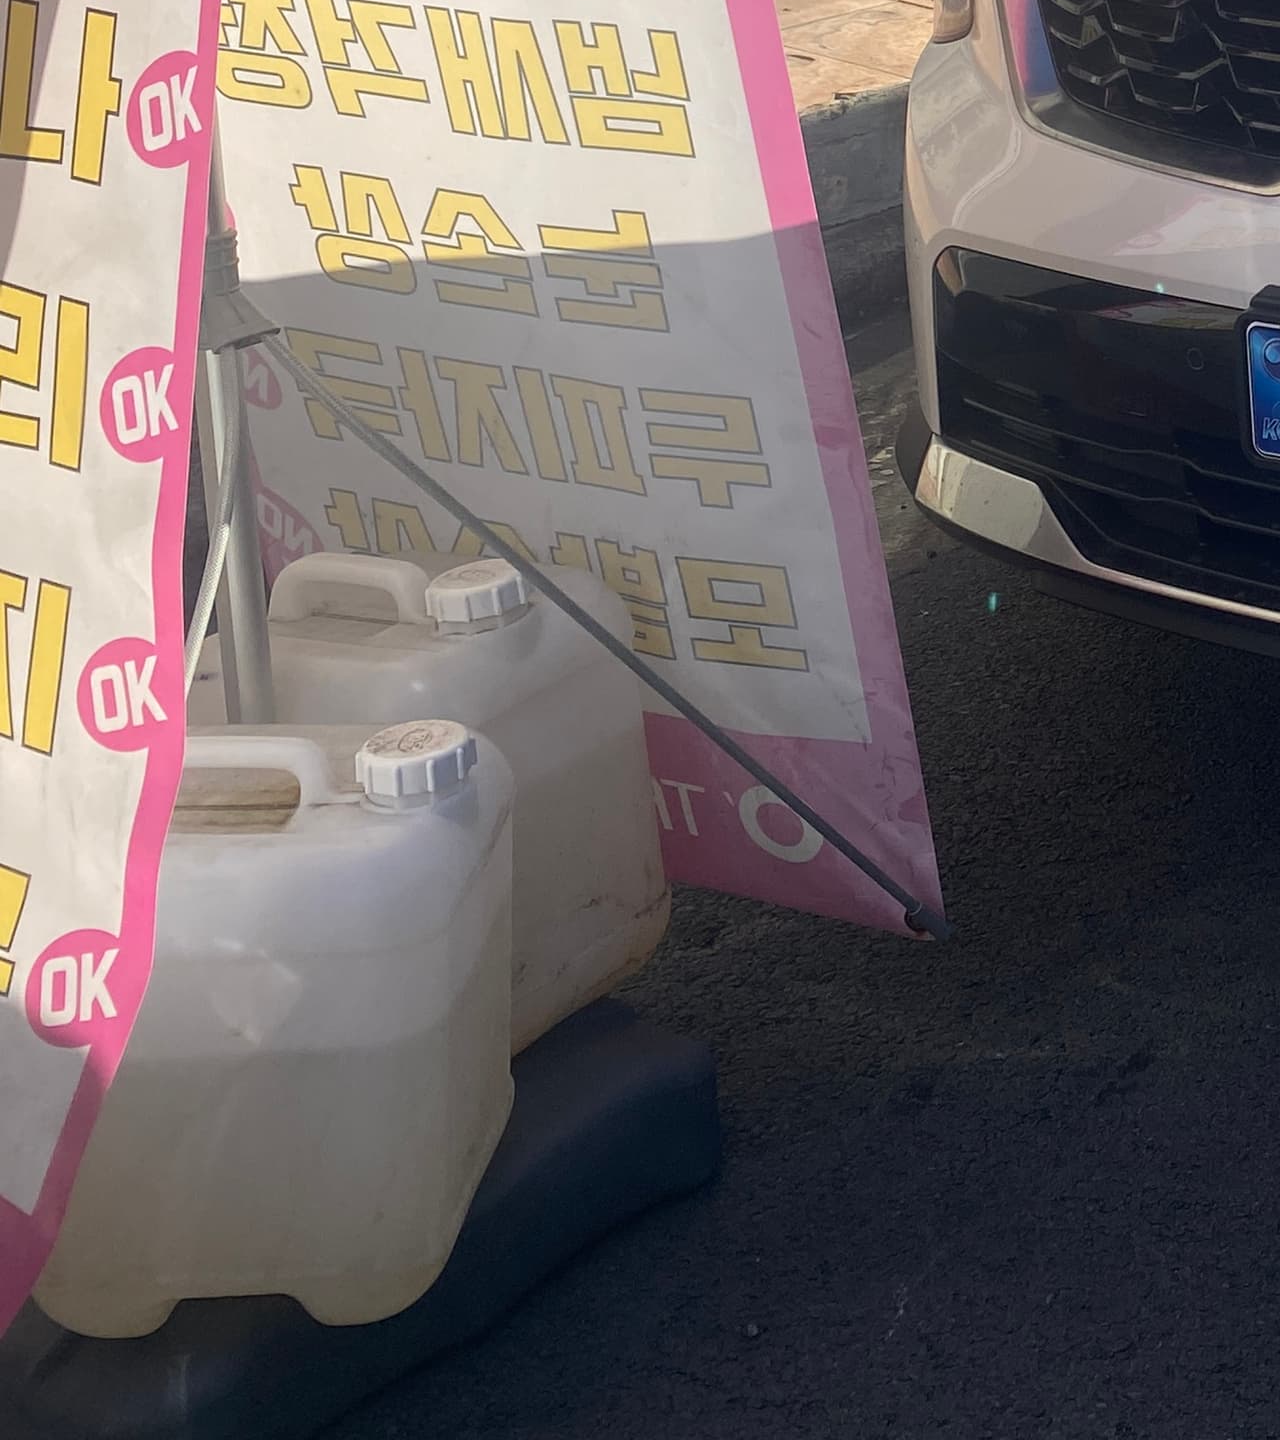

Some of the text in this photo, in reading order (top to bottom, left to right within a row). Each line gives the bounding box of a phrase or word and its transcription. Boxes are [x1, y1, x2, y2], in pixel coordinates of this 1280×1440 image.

[137, 63, 203, 153] OK
[111, 363, 180, 446] OK
[90, 655, 168, 736] OK
[40, 947, 122, 1024] OK
